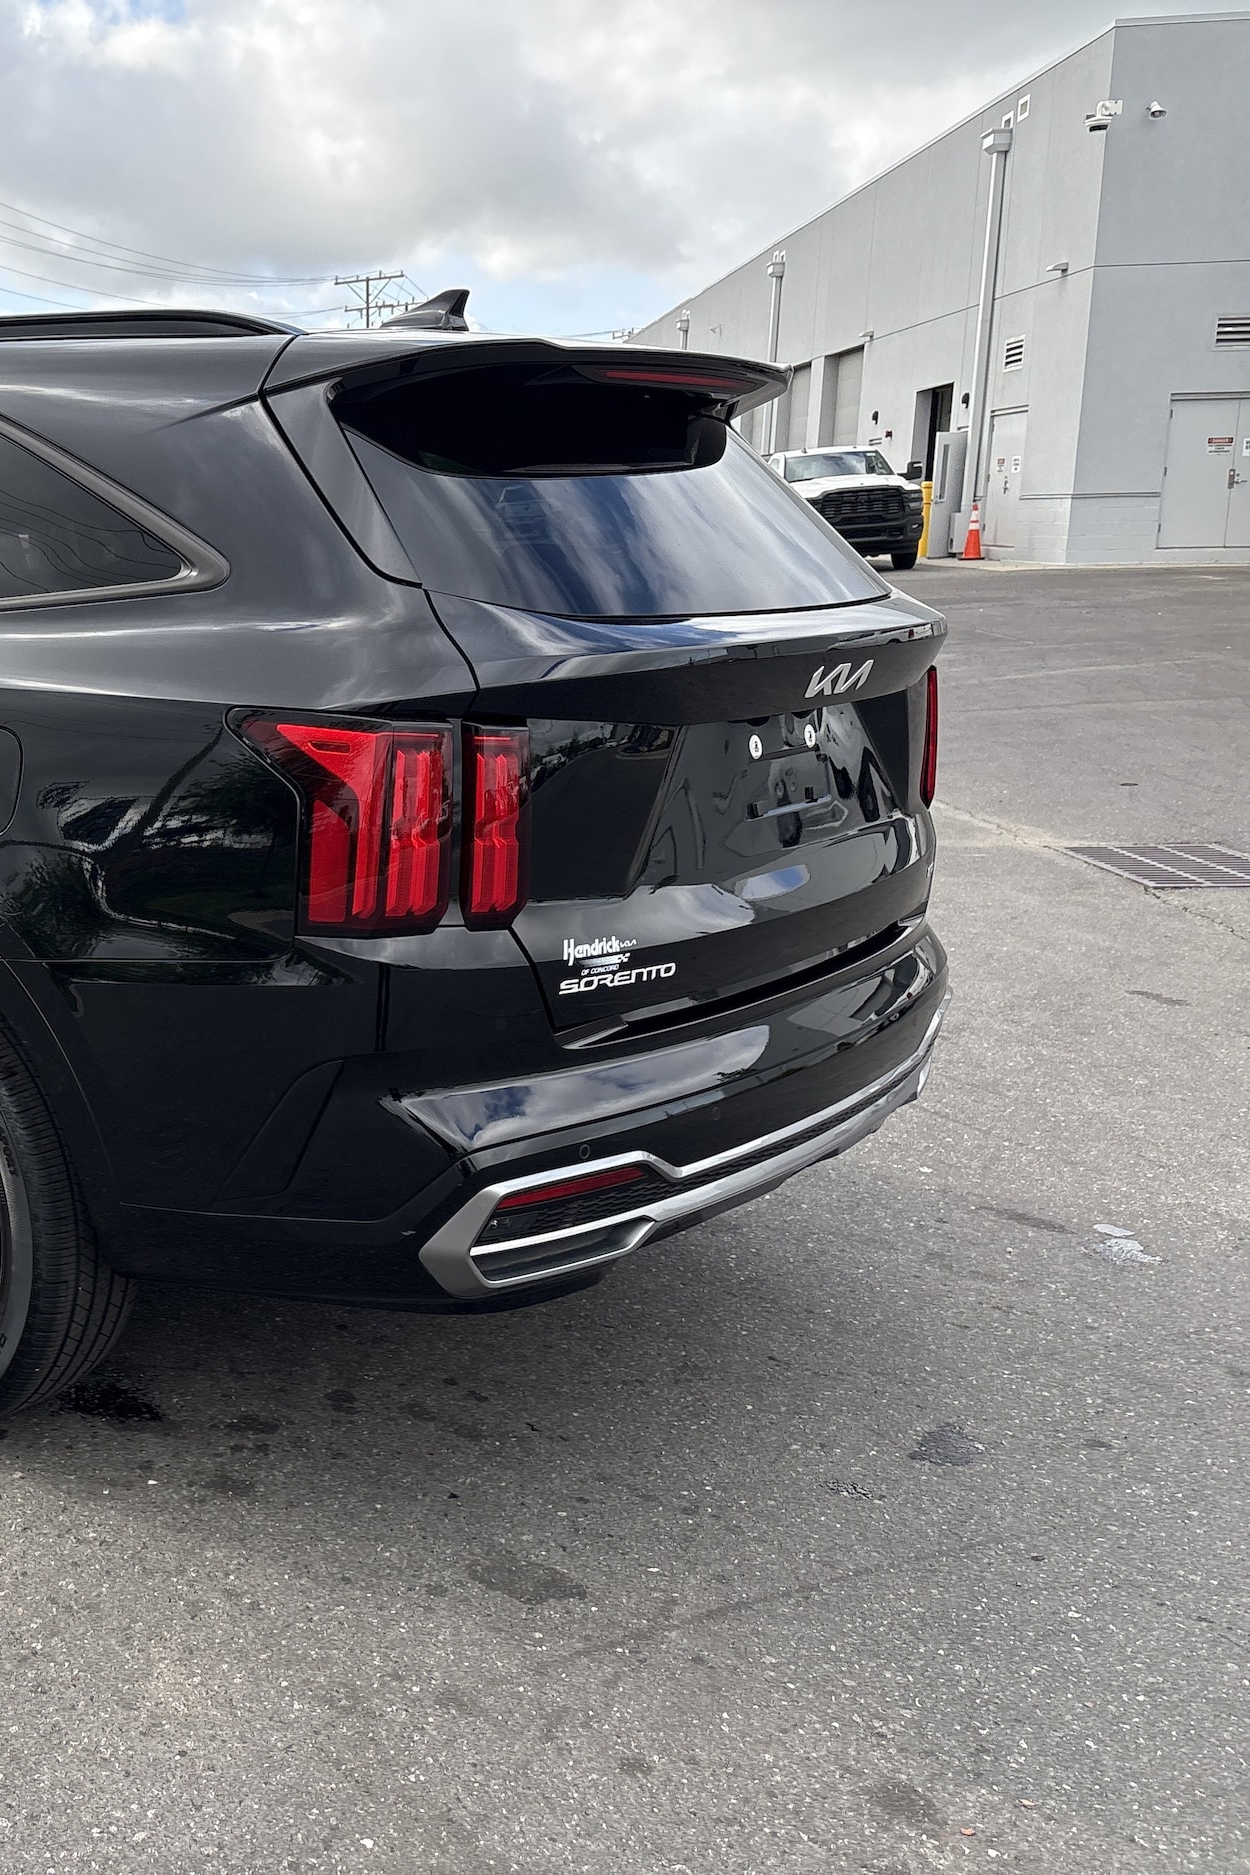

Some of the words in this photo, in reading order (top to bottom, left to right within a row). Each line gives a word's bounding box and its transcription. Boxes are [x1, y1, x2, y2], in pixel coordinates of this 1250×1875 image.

[804, 659, 875, 699] KIA
[563, 936, 620, 966] Hendrick
[559, 962, 676, 995] SORENTO
[590, 964, 620, 974] CONCORD
